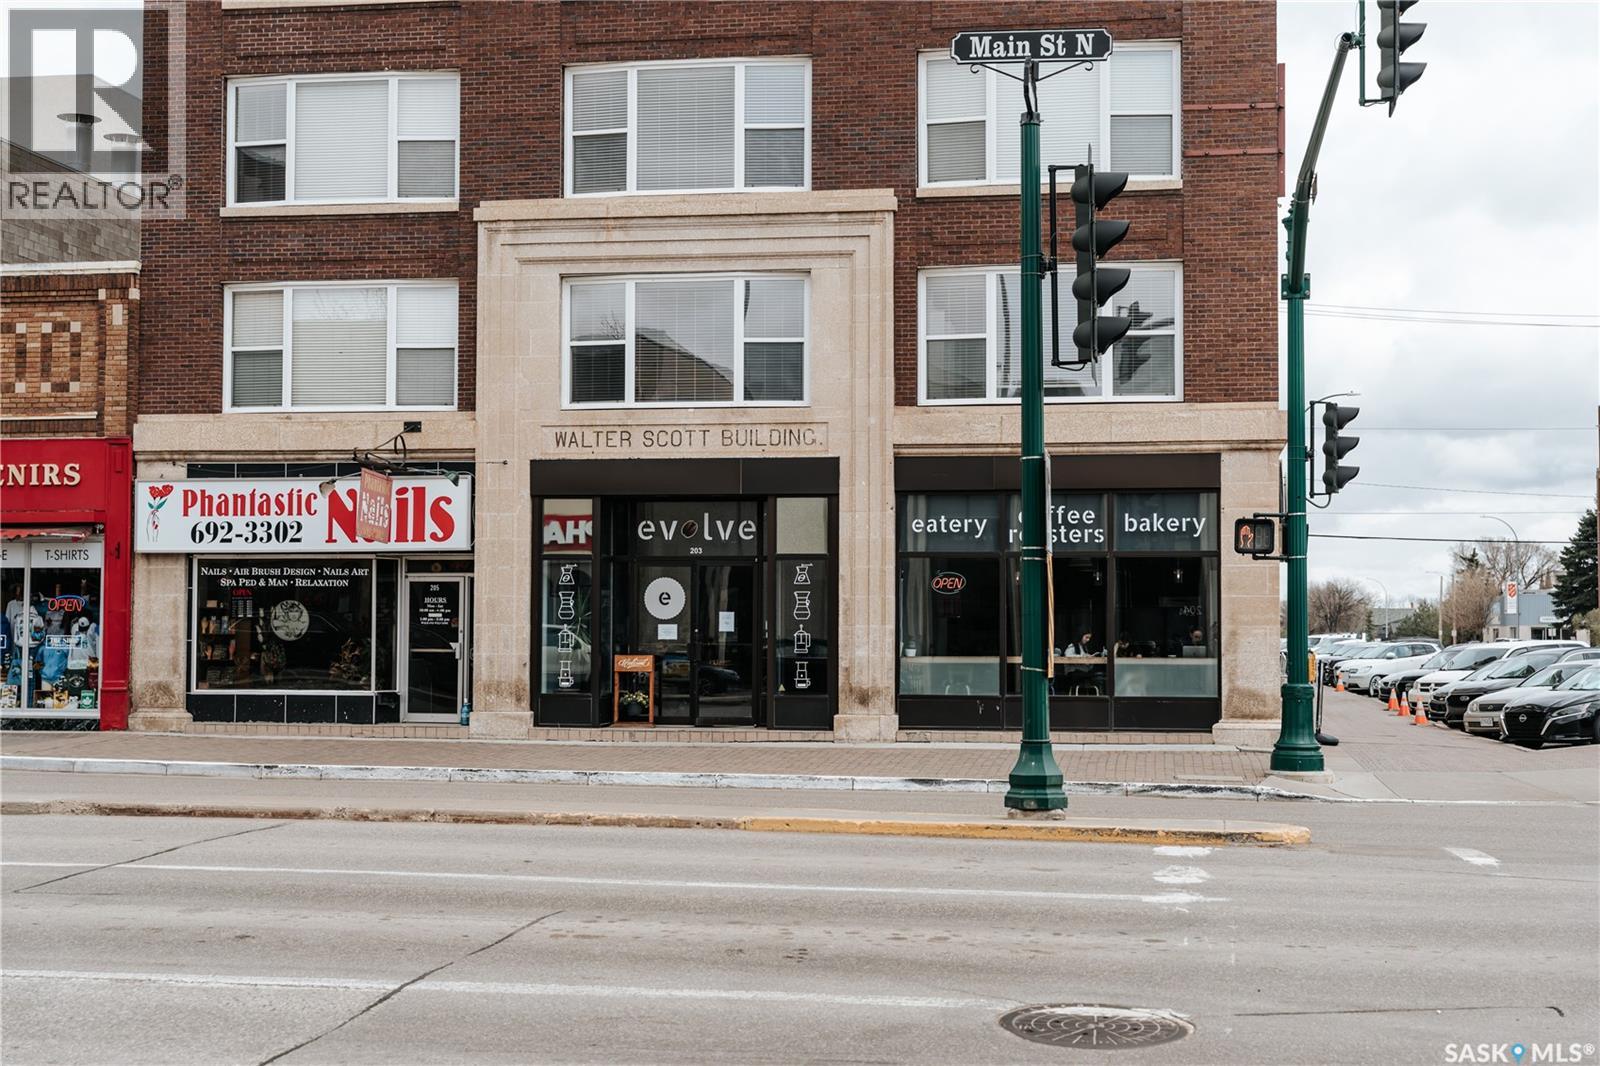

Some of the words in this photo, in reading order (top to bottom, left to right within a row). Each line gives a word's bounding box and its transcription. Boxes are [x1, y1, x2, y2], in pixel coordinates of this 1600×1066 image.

[969, 35, 1031, 58] Main
[1040, 33, 1066, 57] St
[1075, 33, 1095, 56] N
[555, 430, 632, 448] WALTER
[642, 430, 710, 447] SCOTT
[0, 463, 81, 486] NIRS
[182, 488, 318, 517] Phantastic
[325, 486, 455, 544] Nils
[360, 491, 389, 529] Nails
[1018, 505, 1096, 524] fee
[190, 520, 303, 544] 692-3302
[637, 512, 756, 541] evolve
[912, 515, 988, 538] eatery
[1009, 525, 1105, 544] rsters
[1124, 513, 1207, 537] bakery
[45, 549, 89, 561] T-SHIRTS
[689, 547, 703, 555] 203
[201, 567, 227, 576] NAILS
[233, 567, 250, 576] AIR
[251, 567, 281, 576] BRUSH
[283, 567, 316, 576] DESIGN
[322, 567, 350, 576] NAILS
[351, 567, 370, 576] ART
[220, 578, 237, 587] SPA
[238, 578, 257, 587] PED
[258, 578, 266, 587] &
[268, 578, 288, 587] MAN
[295, 578, 350, 587] RELAXATION
[932, 578, 963, 589] OPEN
[47, 598, 83, 612] OPEN
[658, 592, 671, 606] e
